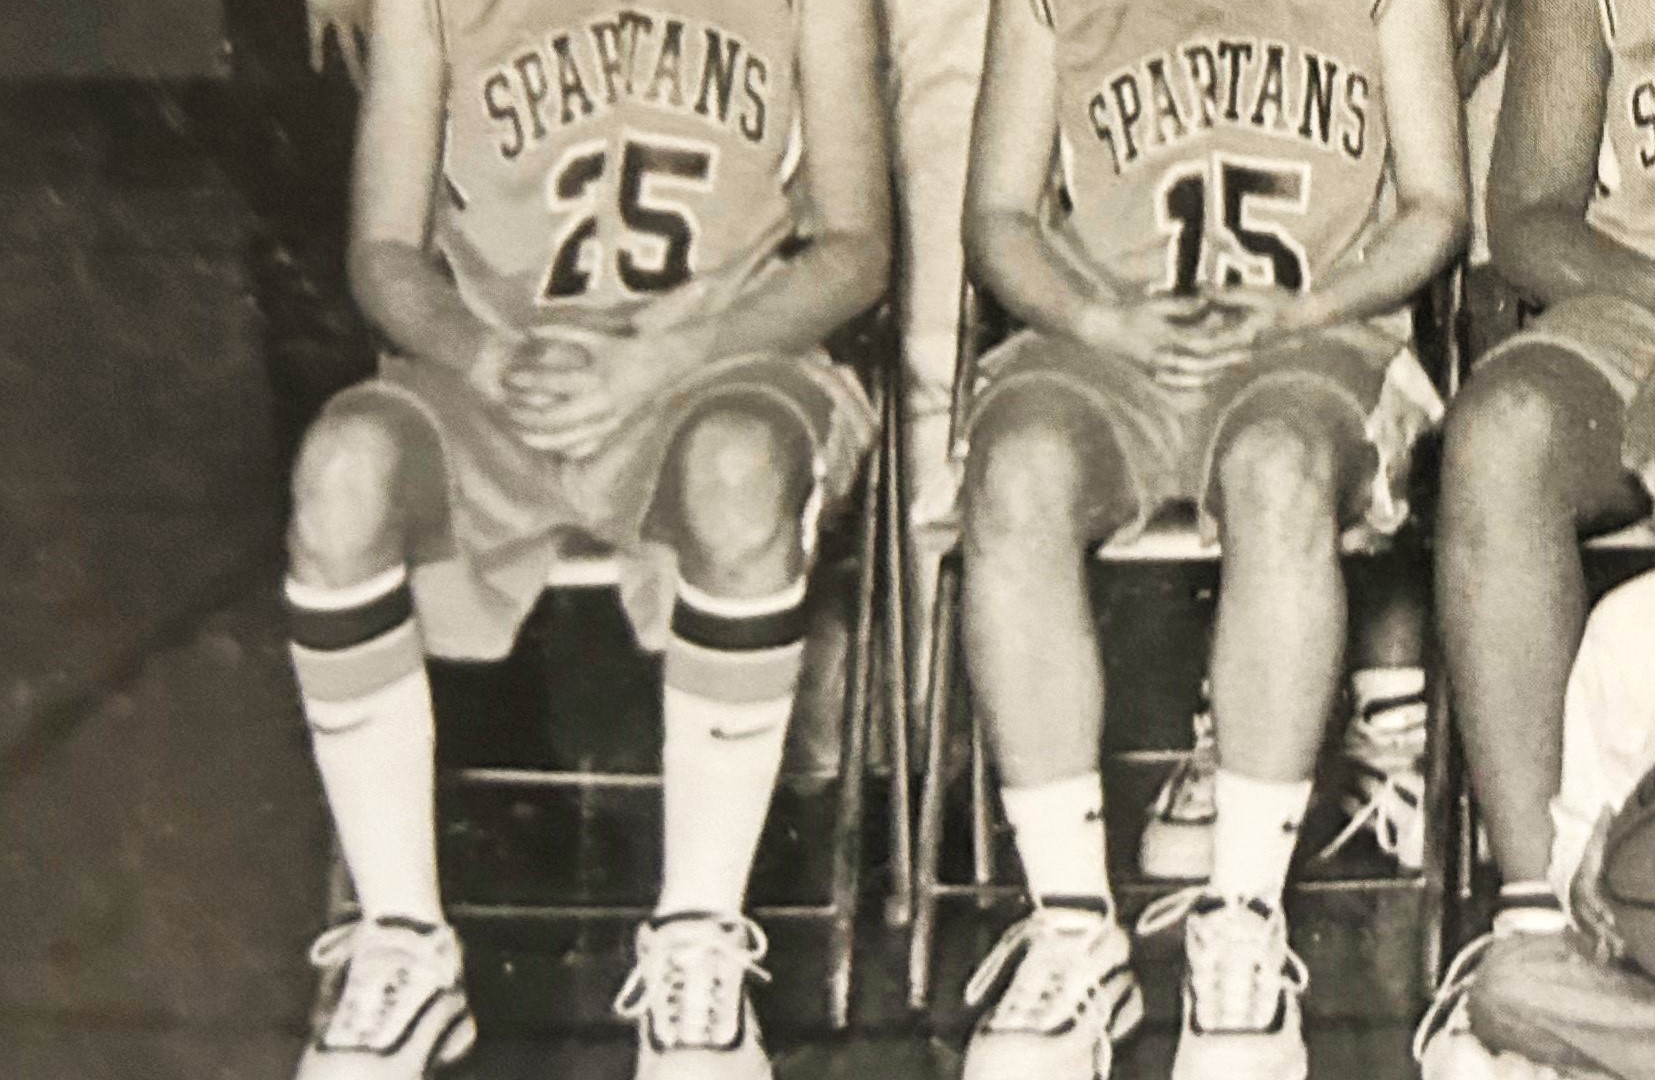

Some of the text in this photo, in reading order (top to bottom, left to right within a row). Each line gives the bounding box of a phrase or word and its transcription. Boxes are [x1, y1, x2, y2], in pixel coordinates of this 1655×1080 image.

[482, 10, 768, 160] SPARTANS
[1087, 38, 1370, 175] SPARTANS
[540, 136, 714, 301] 25
[1160, 158, 1308, 296] 15
